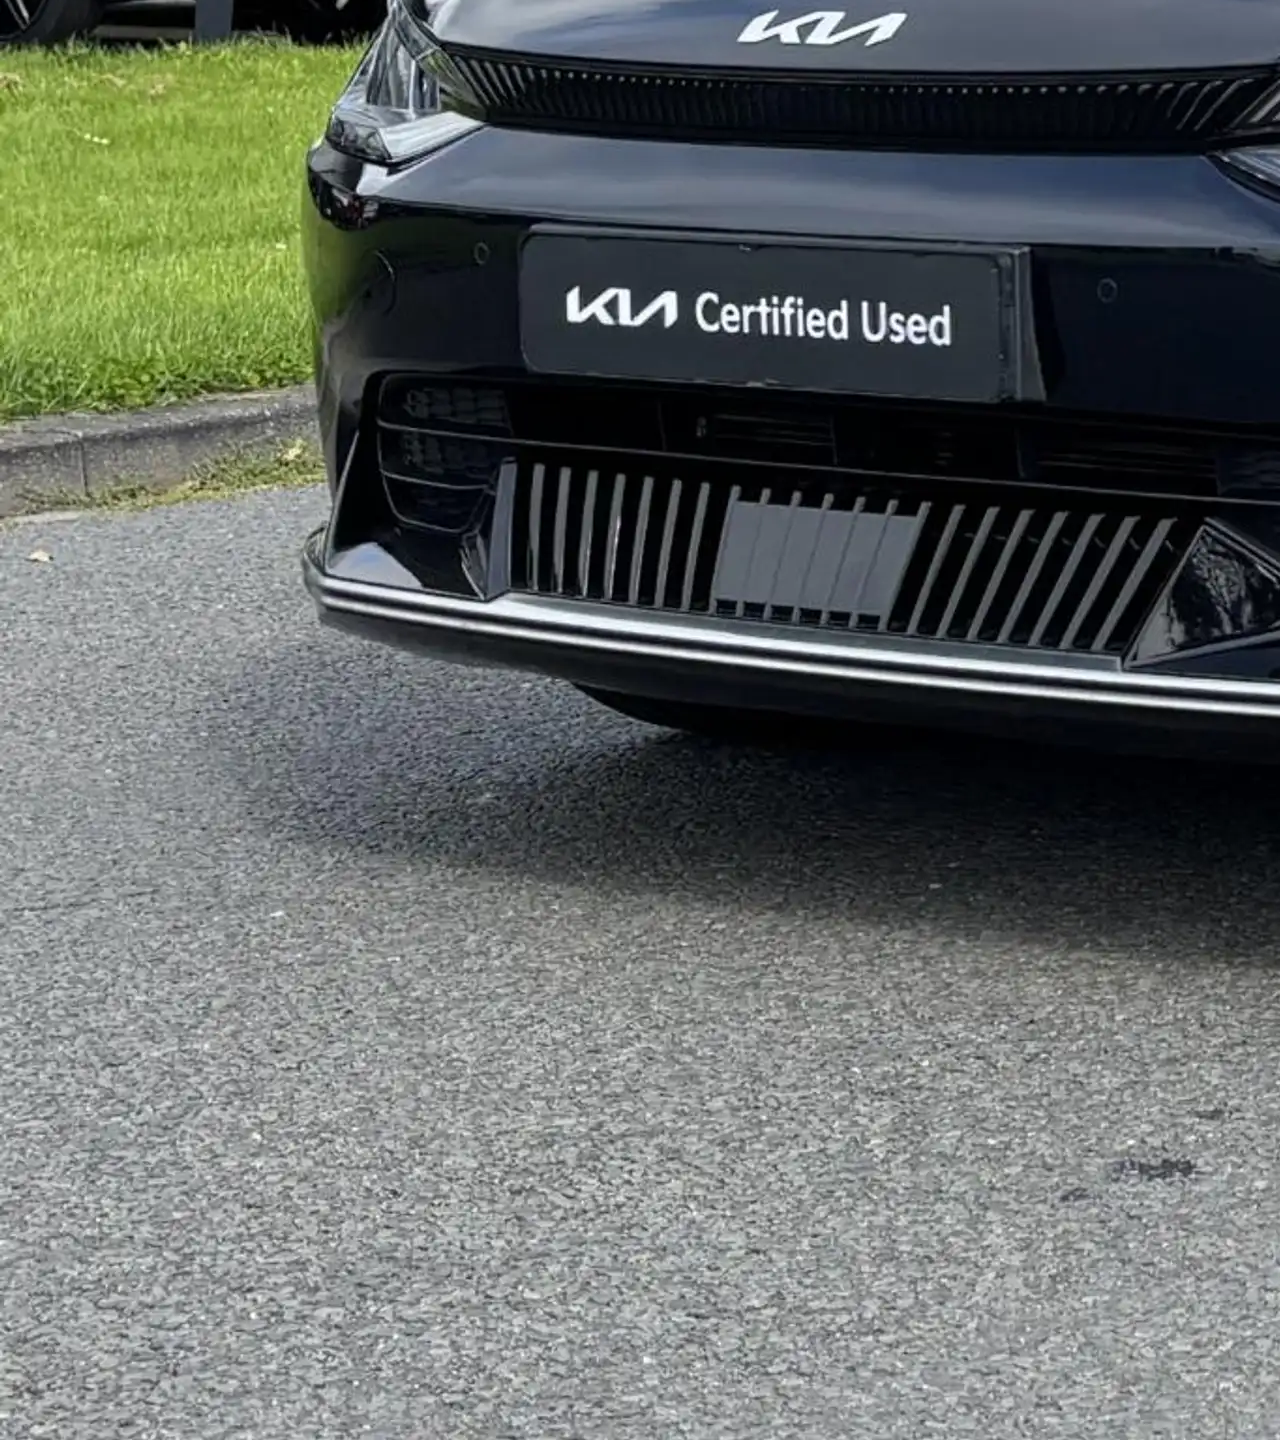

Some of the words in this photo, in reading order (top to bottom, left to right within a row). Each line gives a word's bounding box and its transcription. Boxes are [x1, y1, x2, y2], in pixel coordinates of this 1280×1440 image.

[737, 10, 907, 46] KIA
[565, 285, 679, 329] KIA
[695, 291, 849, 341] Certified
[860, 301, 952, 347] Used
